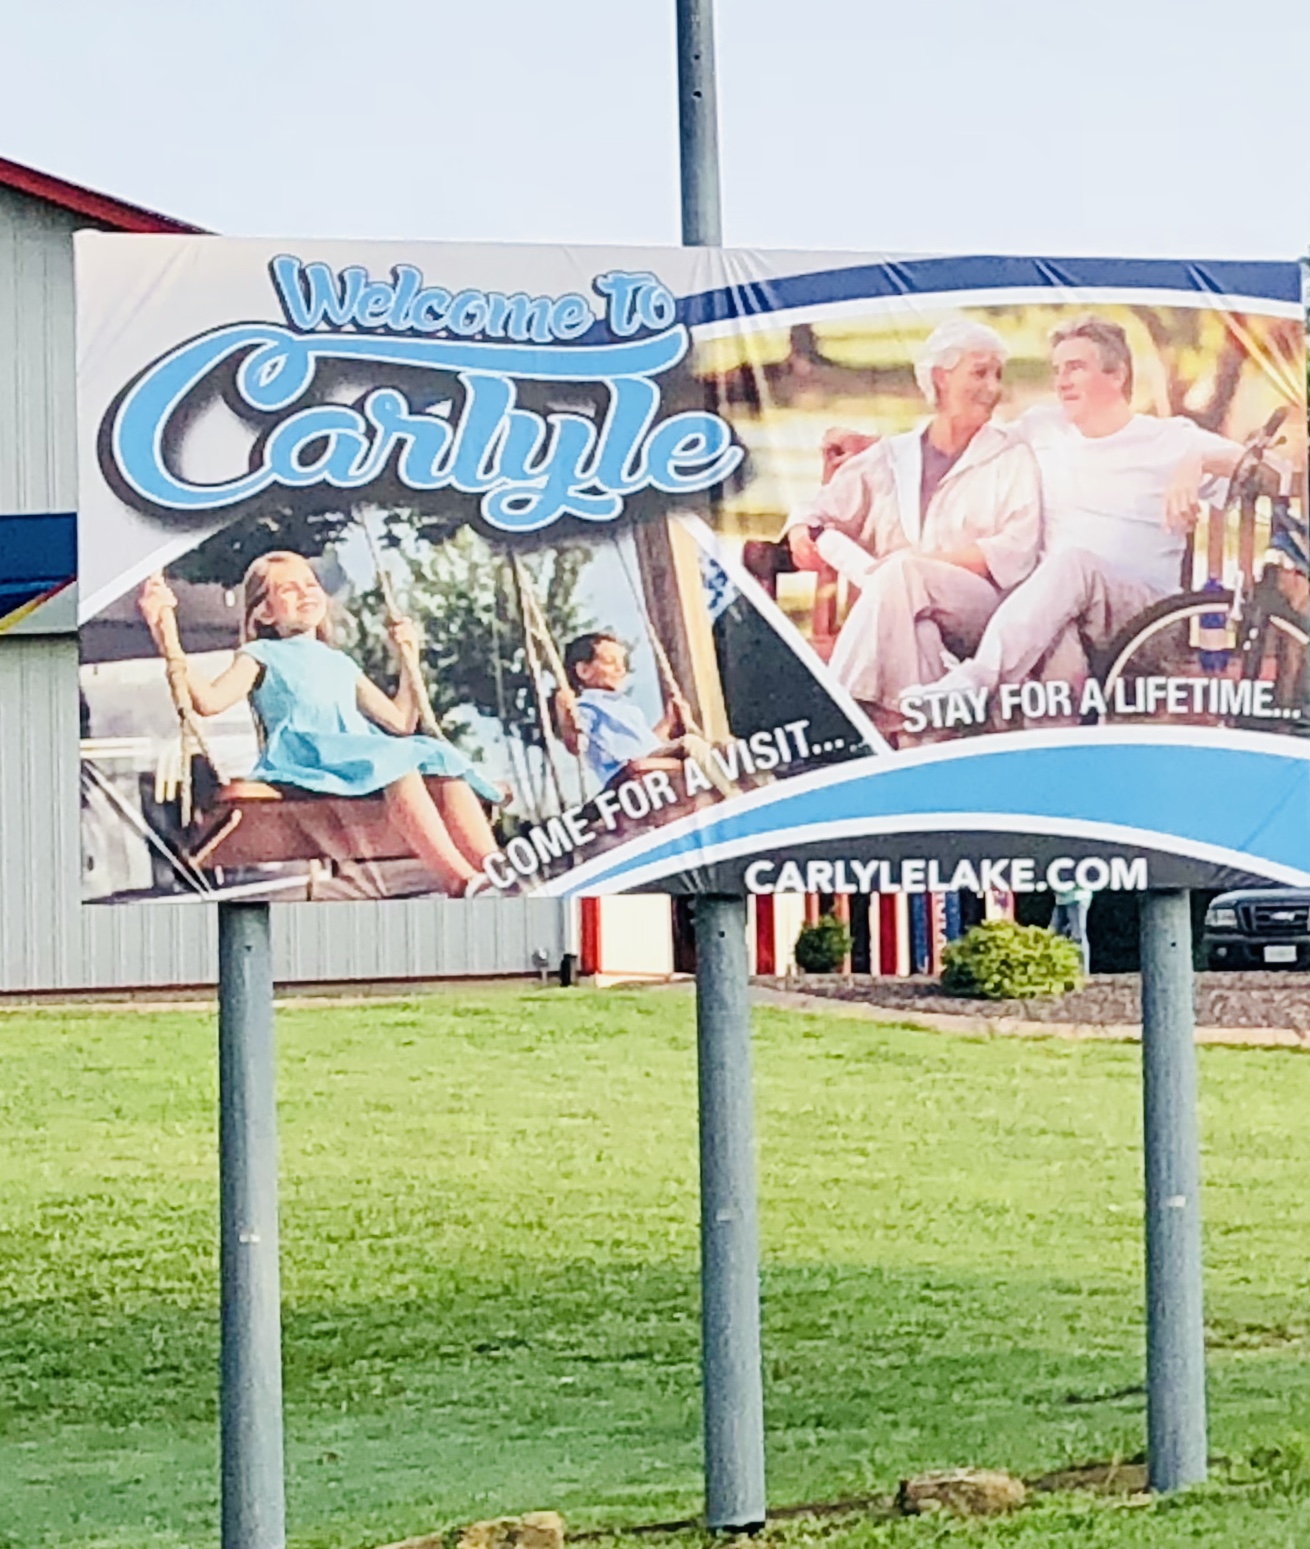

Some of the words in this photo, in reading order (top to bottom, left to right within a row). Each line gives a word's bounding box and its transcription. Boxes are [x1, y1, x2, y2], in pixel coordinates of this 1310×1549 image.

[271, 254, 592, 341] Welcome
[108, 321, 743, 531] Carlyle
[901, 687, 988, 733] STAY
[1000, 680, 1072, 720] FOR
[1080, 677, 1108, 716] A
[1115, 677, 1302, 720] LIFETIME...
[483, 805, 596, 890] COME
[596, 769, 677, 832] FOR
[684, 759, 711, 796] A
[744, 857, 1148, 893] CARLYLELAKE.COM
